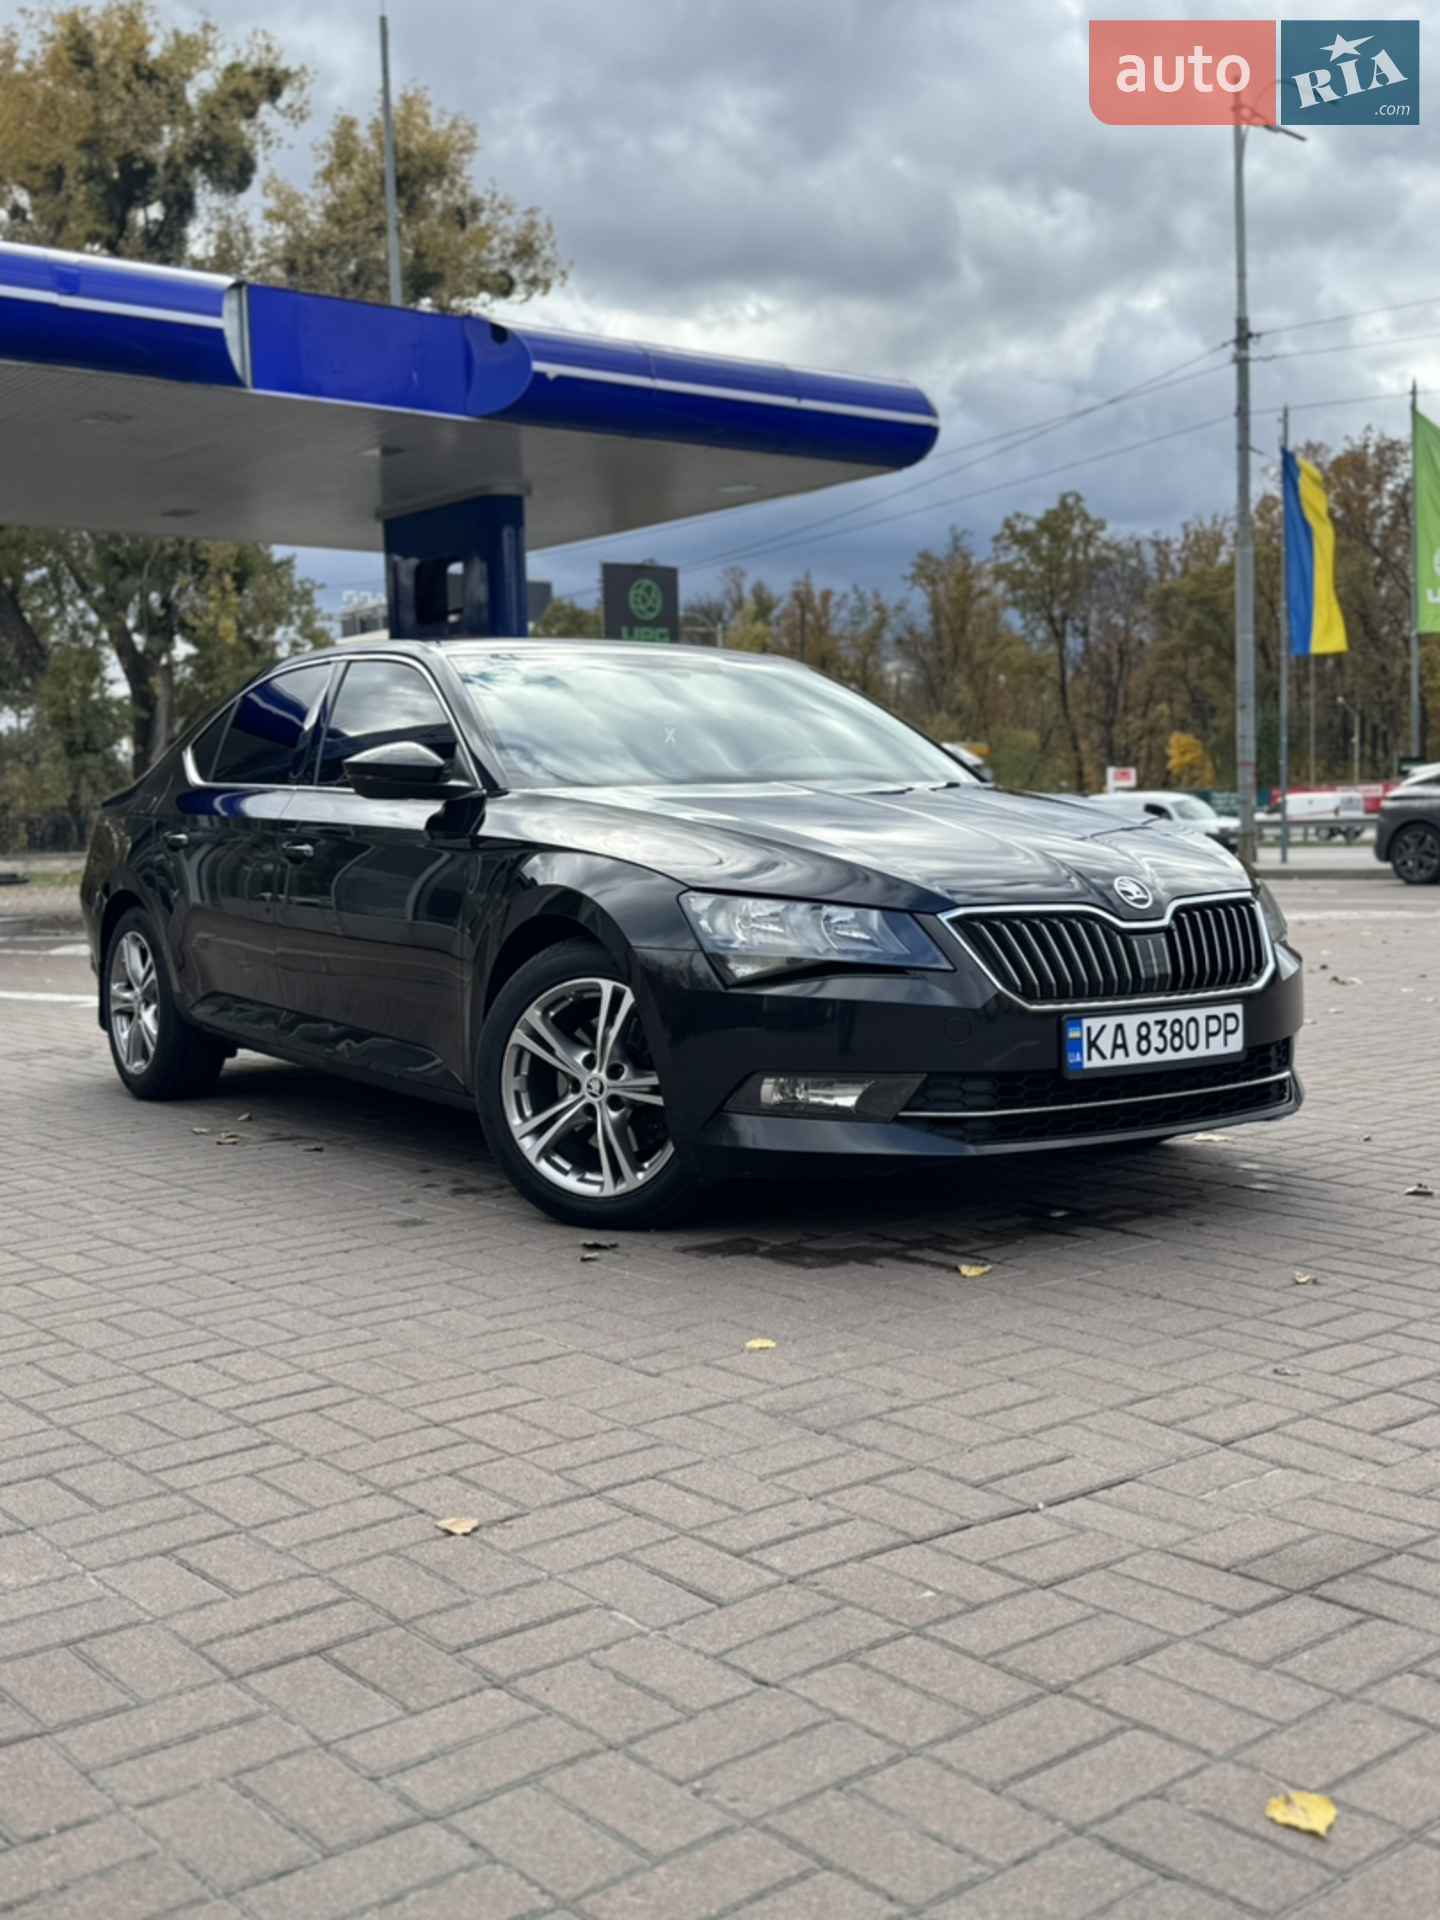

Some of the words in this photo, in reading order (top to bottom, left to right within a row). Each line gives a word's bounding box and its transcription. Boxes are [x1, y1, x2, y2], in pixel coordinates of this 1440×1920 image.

[1086, 1022, 1129, 1062] KA
[1136, 1015, 1200, 1057] 8380
[1205, 1012, 1240, 1050] PP
[1067, 1051, 1082, 1063] UA
